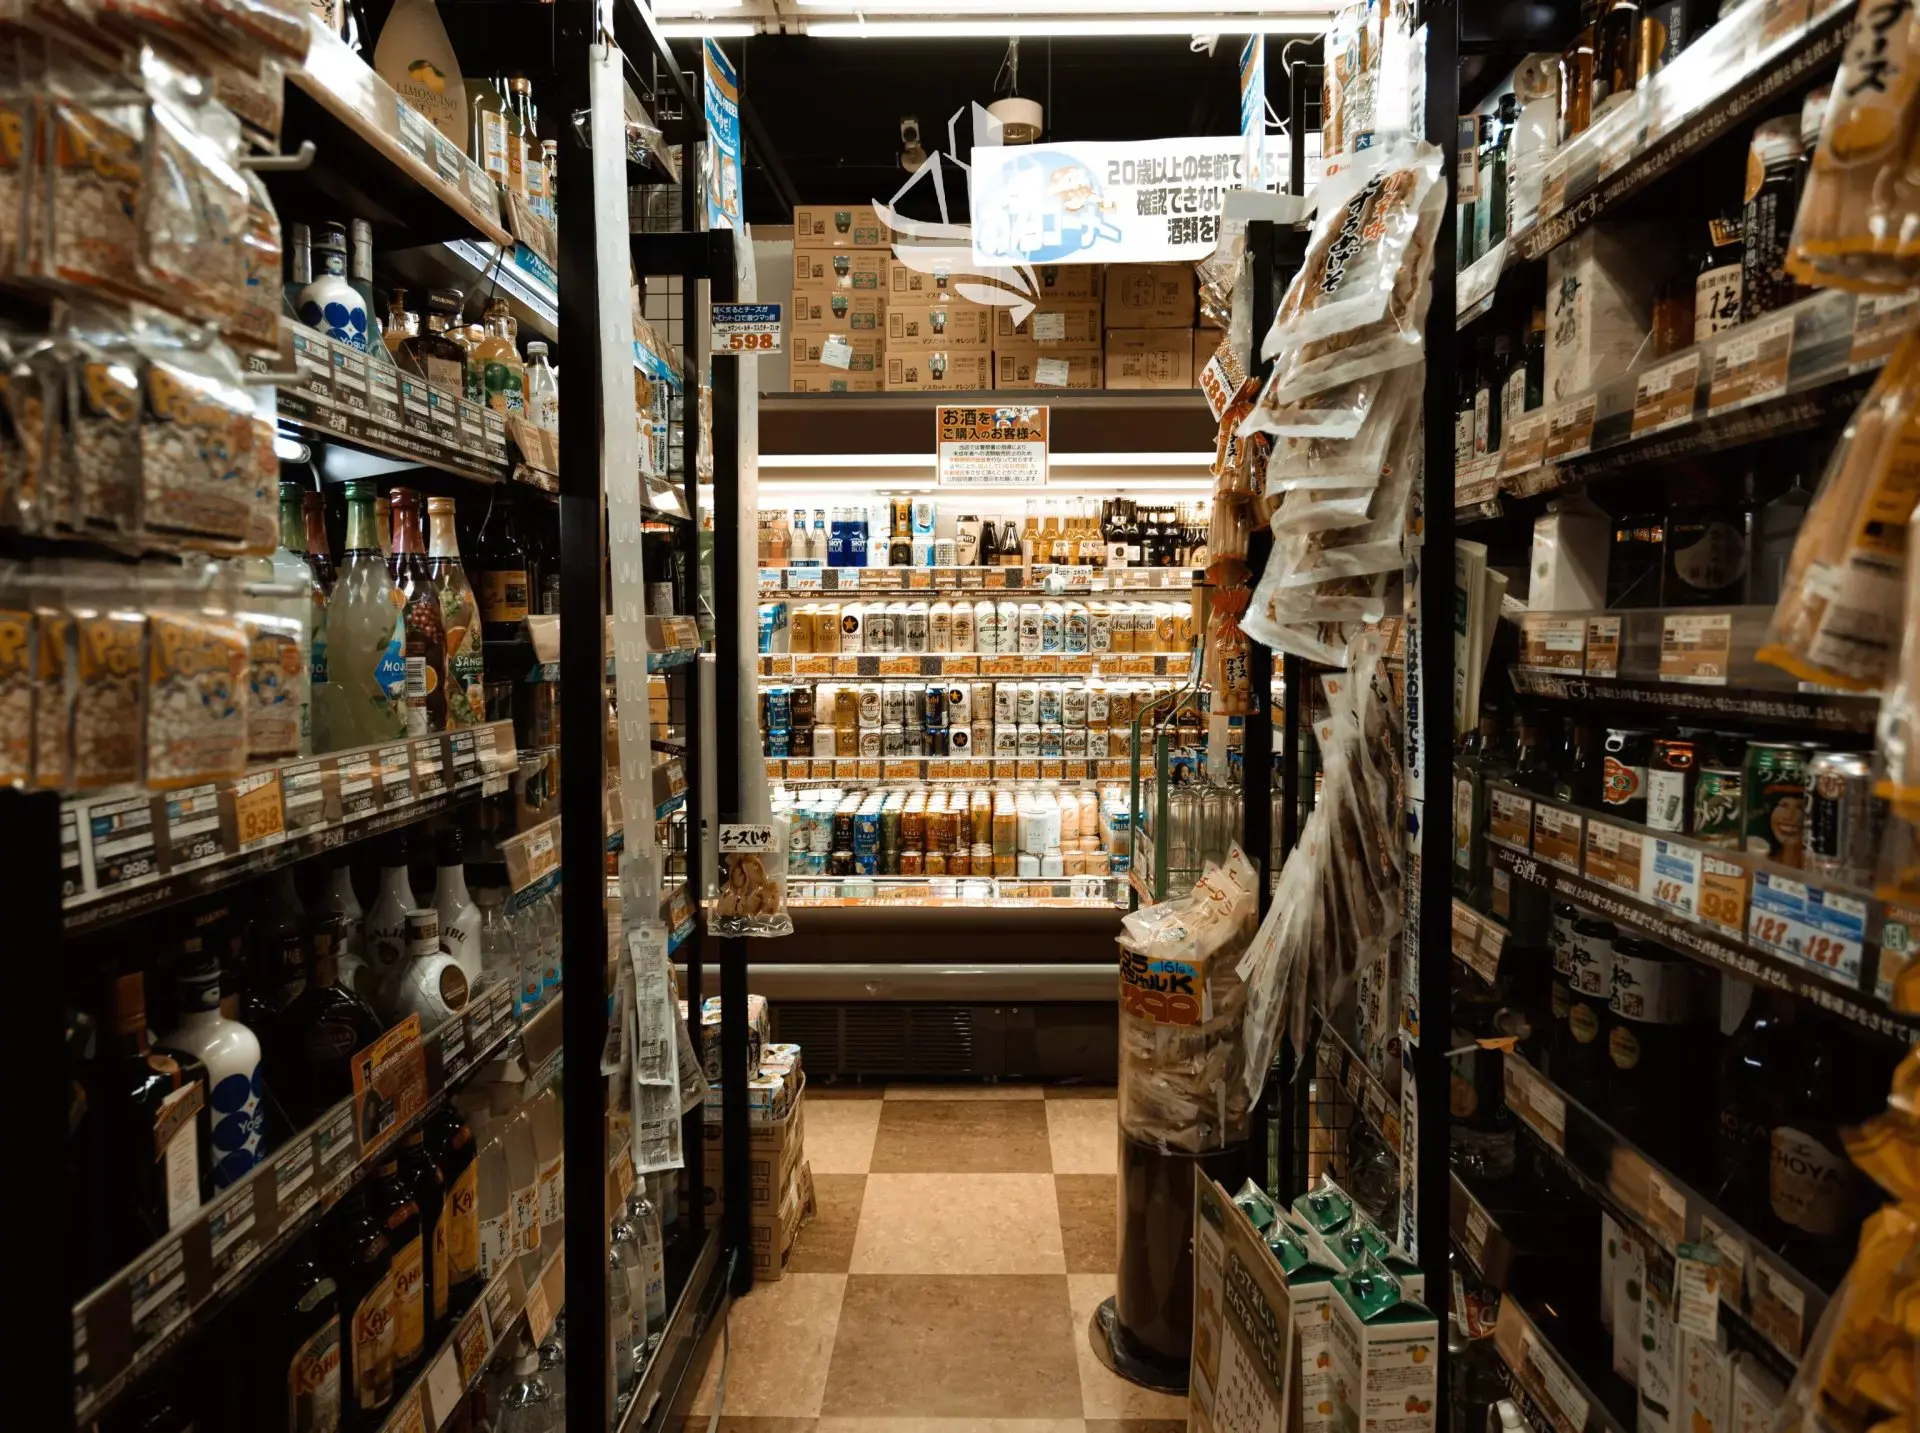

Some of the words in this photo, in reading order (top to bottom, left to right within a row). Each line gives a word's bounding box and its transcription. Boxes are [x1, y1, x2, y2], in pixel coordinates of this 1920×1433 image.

[1167, 217, 1220, 246] 酒類を
[730, 333, 773, 350] 598
[1202, 366, 1228, 412] 388
[943, 409, 991, 426] お酒を
[943, 427, 1041, 441] ご購入のお客様へ
[907, 630, 926, 639] Asahi
[721, 830, 771, 845] チーズいか
[122, 859, 149, 878] 998
[1702, 896, 1741, 925] 98
